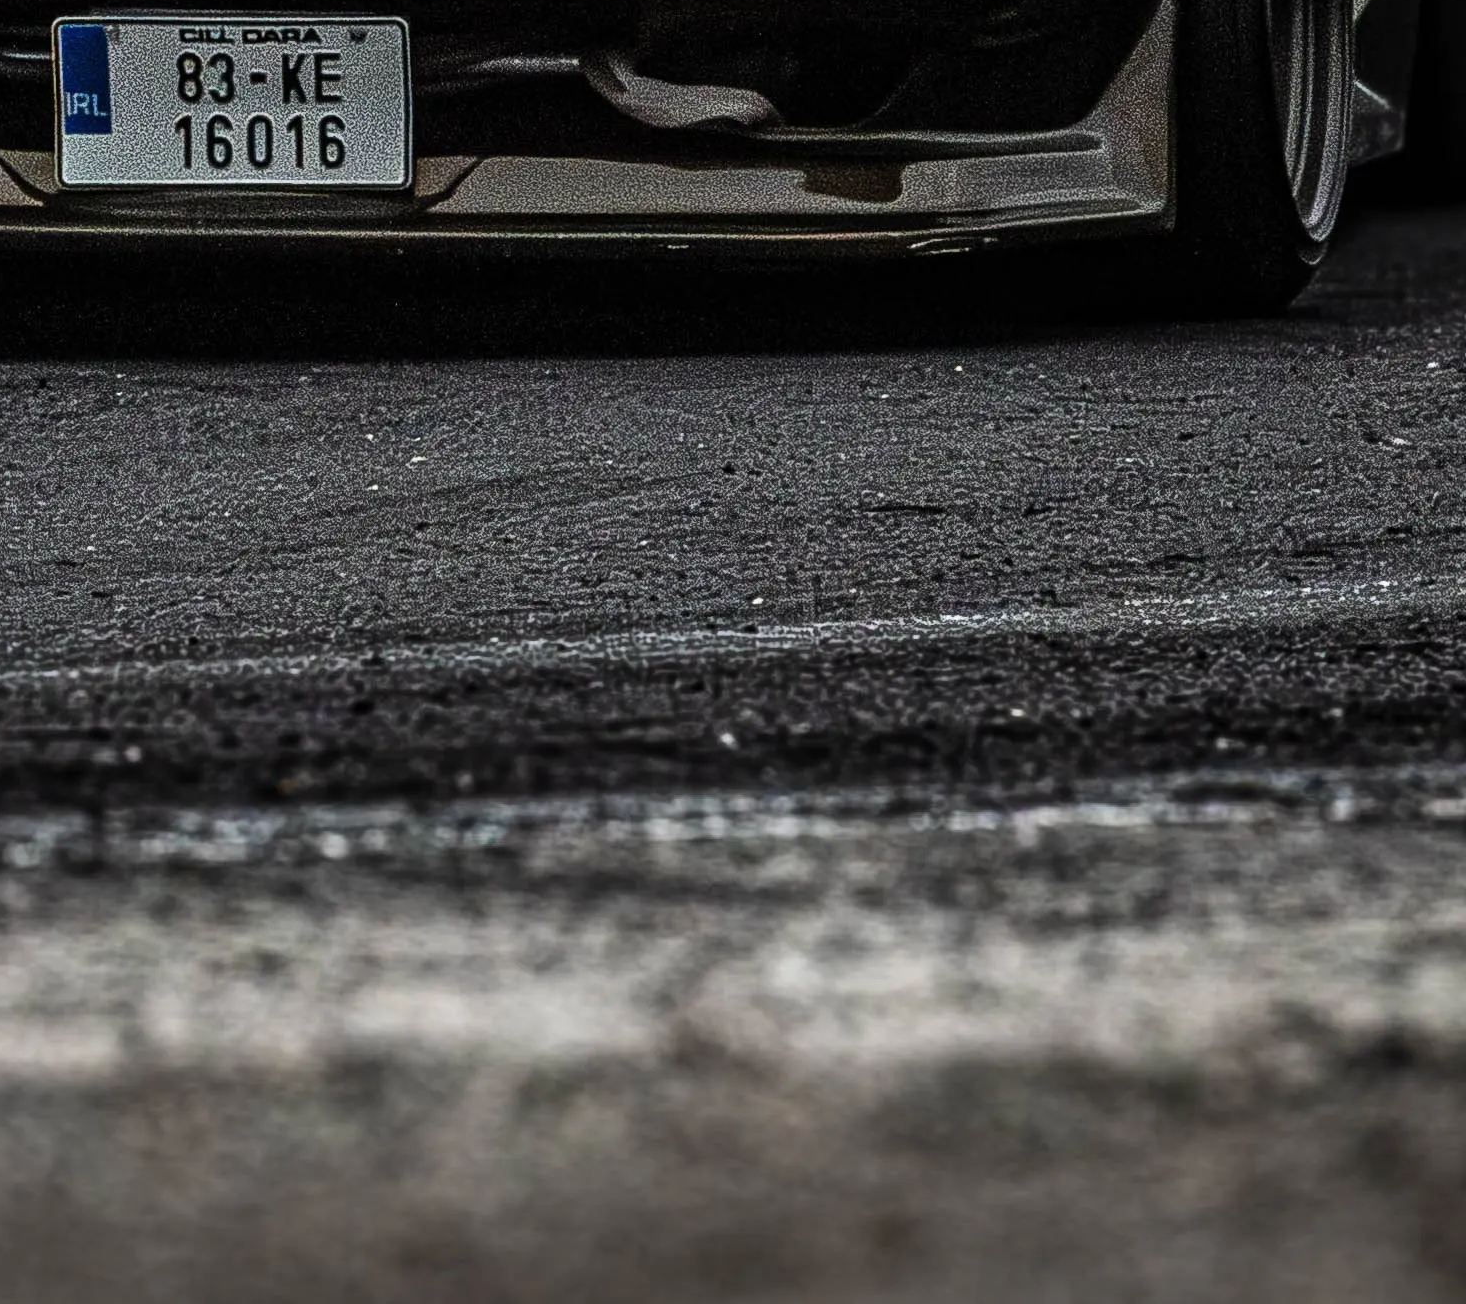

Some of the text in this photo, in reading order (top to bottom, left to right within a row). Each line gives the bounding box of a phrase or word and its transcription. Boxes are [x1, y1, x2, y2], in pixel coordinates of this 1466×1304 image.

[242, 27, 322, 44] DARA
[67, 93, 108, 116] IRL
[175, 114, 347, 169] 16016
